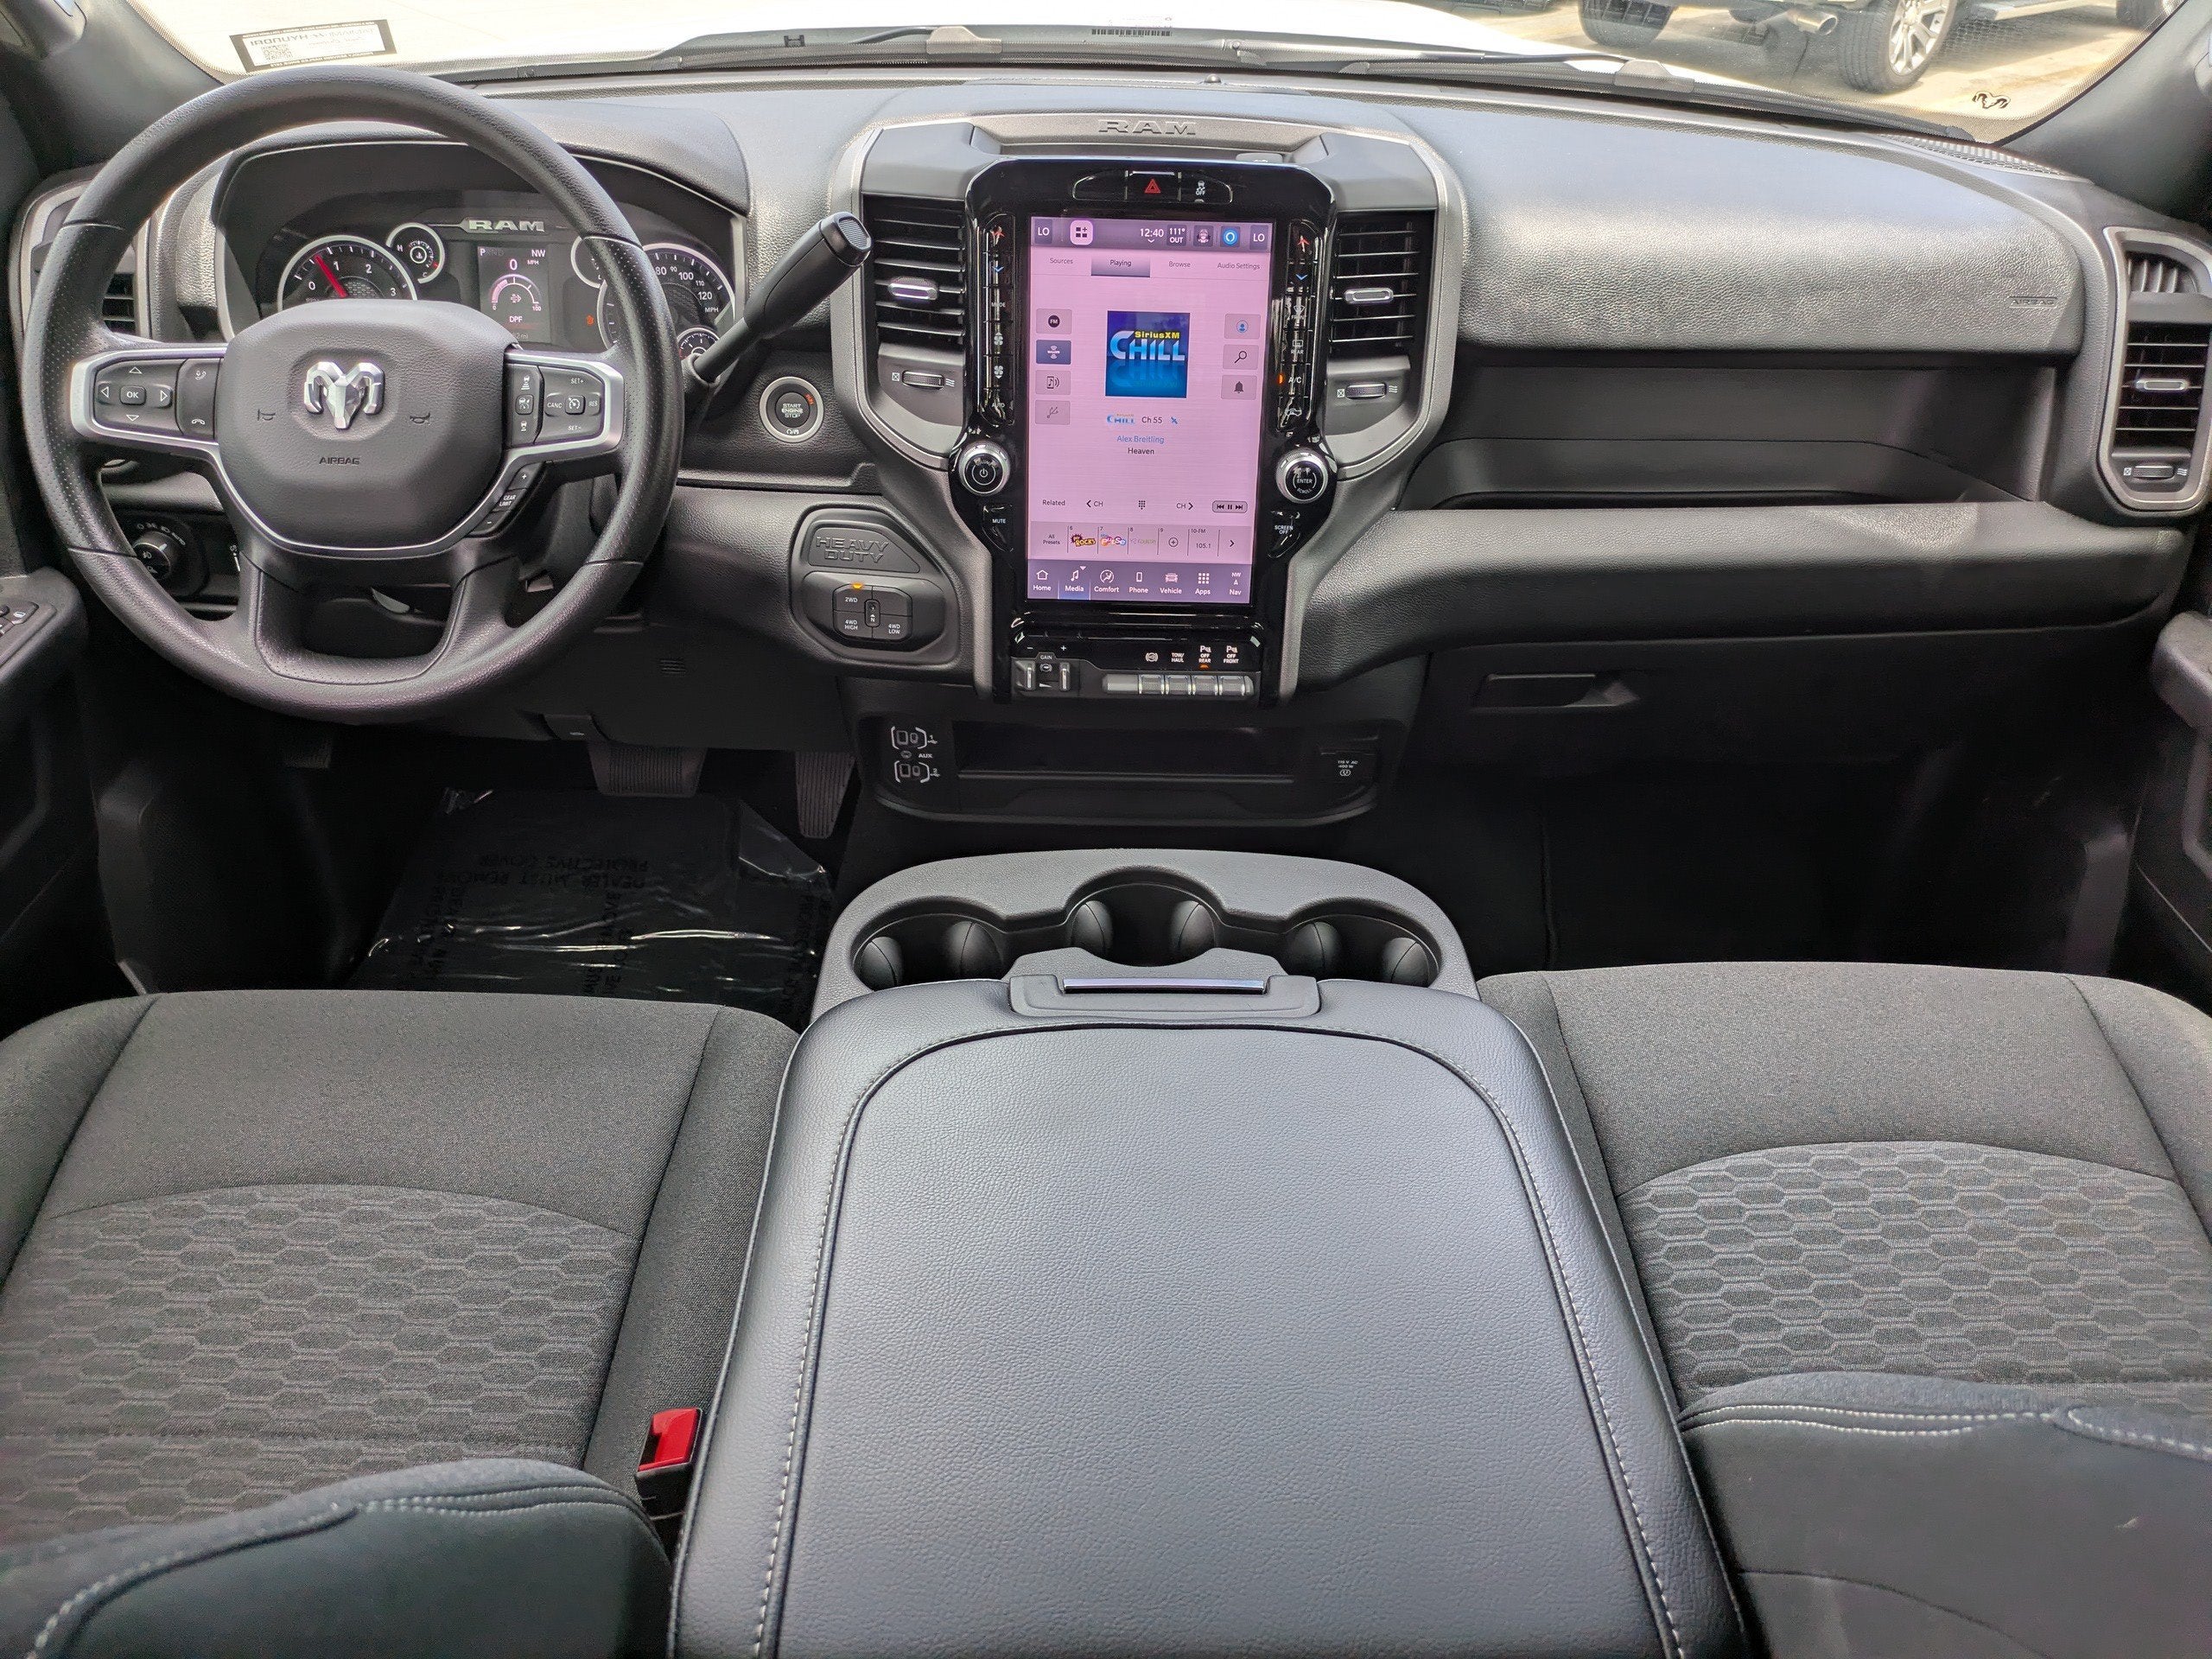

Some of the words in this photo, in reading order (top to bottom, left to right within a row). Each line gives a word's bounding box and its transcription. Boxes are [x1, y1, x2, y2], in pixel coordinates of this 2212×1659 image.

[1098, 119, 1196, 135] RAM
[468, 219, 544, 232] RAM
[1038, 227, 1050, 236] LO
[1140, 228, 1164, 238] 12:40
[1253, 232, 1265, 242] LO
[531, 249, 546, 257] NW
[334, 261, 340, 271] 1
[509, 258, 518, 270] 0
[1109, 259, 1132, 268] Playing
[1237, 263, 1261, 271] Settings
[365, 264, 372, 274] 2
[656, 266, 667, 276] 80
[678, 271, 694, 281] 100
[308, 282, 315, 290] 0
[391, 287, 397, 296] 3
[697, 291, 713, 301] 120
[1135, 331, 1180, 340] SiriusXM
[1110, 330, 1185, 361] CHILL
[1288, 376, 1302, 385] A/C
[126, 391, 139, 399] OK
[1134, 435, 1165, 445] Breitling
[319, 456, 360, 465] AIRBAG
[1042, 499, 1065, 507] Related
[816, 536, 889, 552] HEAVY
[1075, 538, 1096, 547] ROCKS
[824, 549, 884, 563] DUTY
[1094, 585, 1120, 594] Comfort
[1194, 588, 1211, 596] Apps
